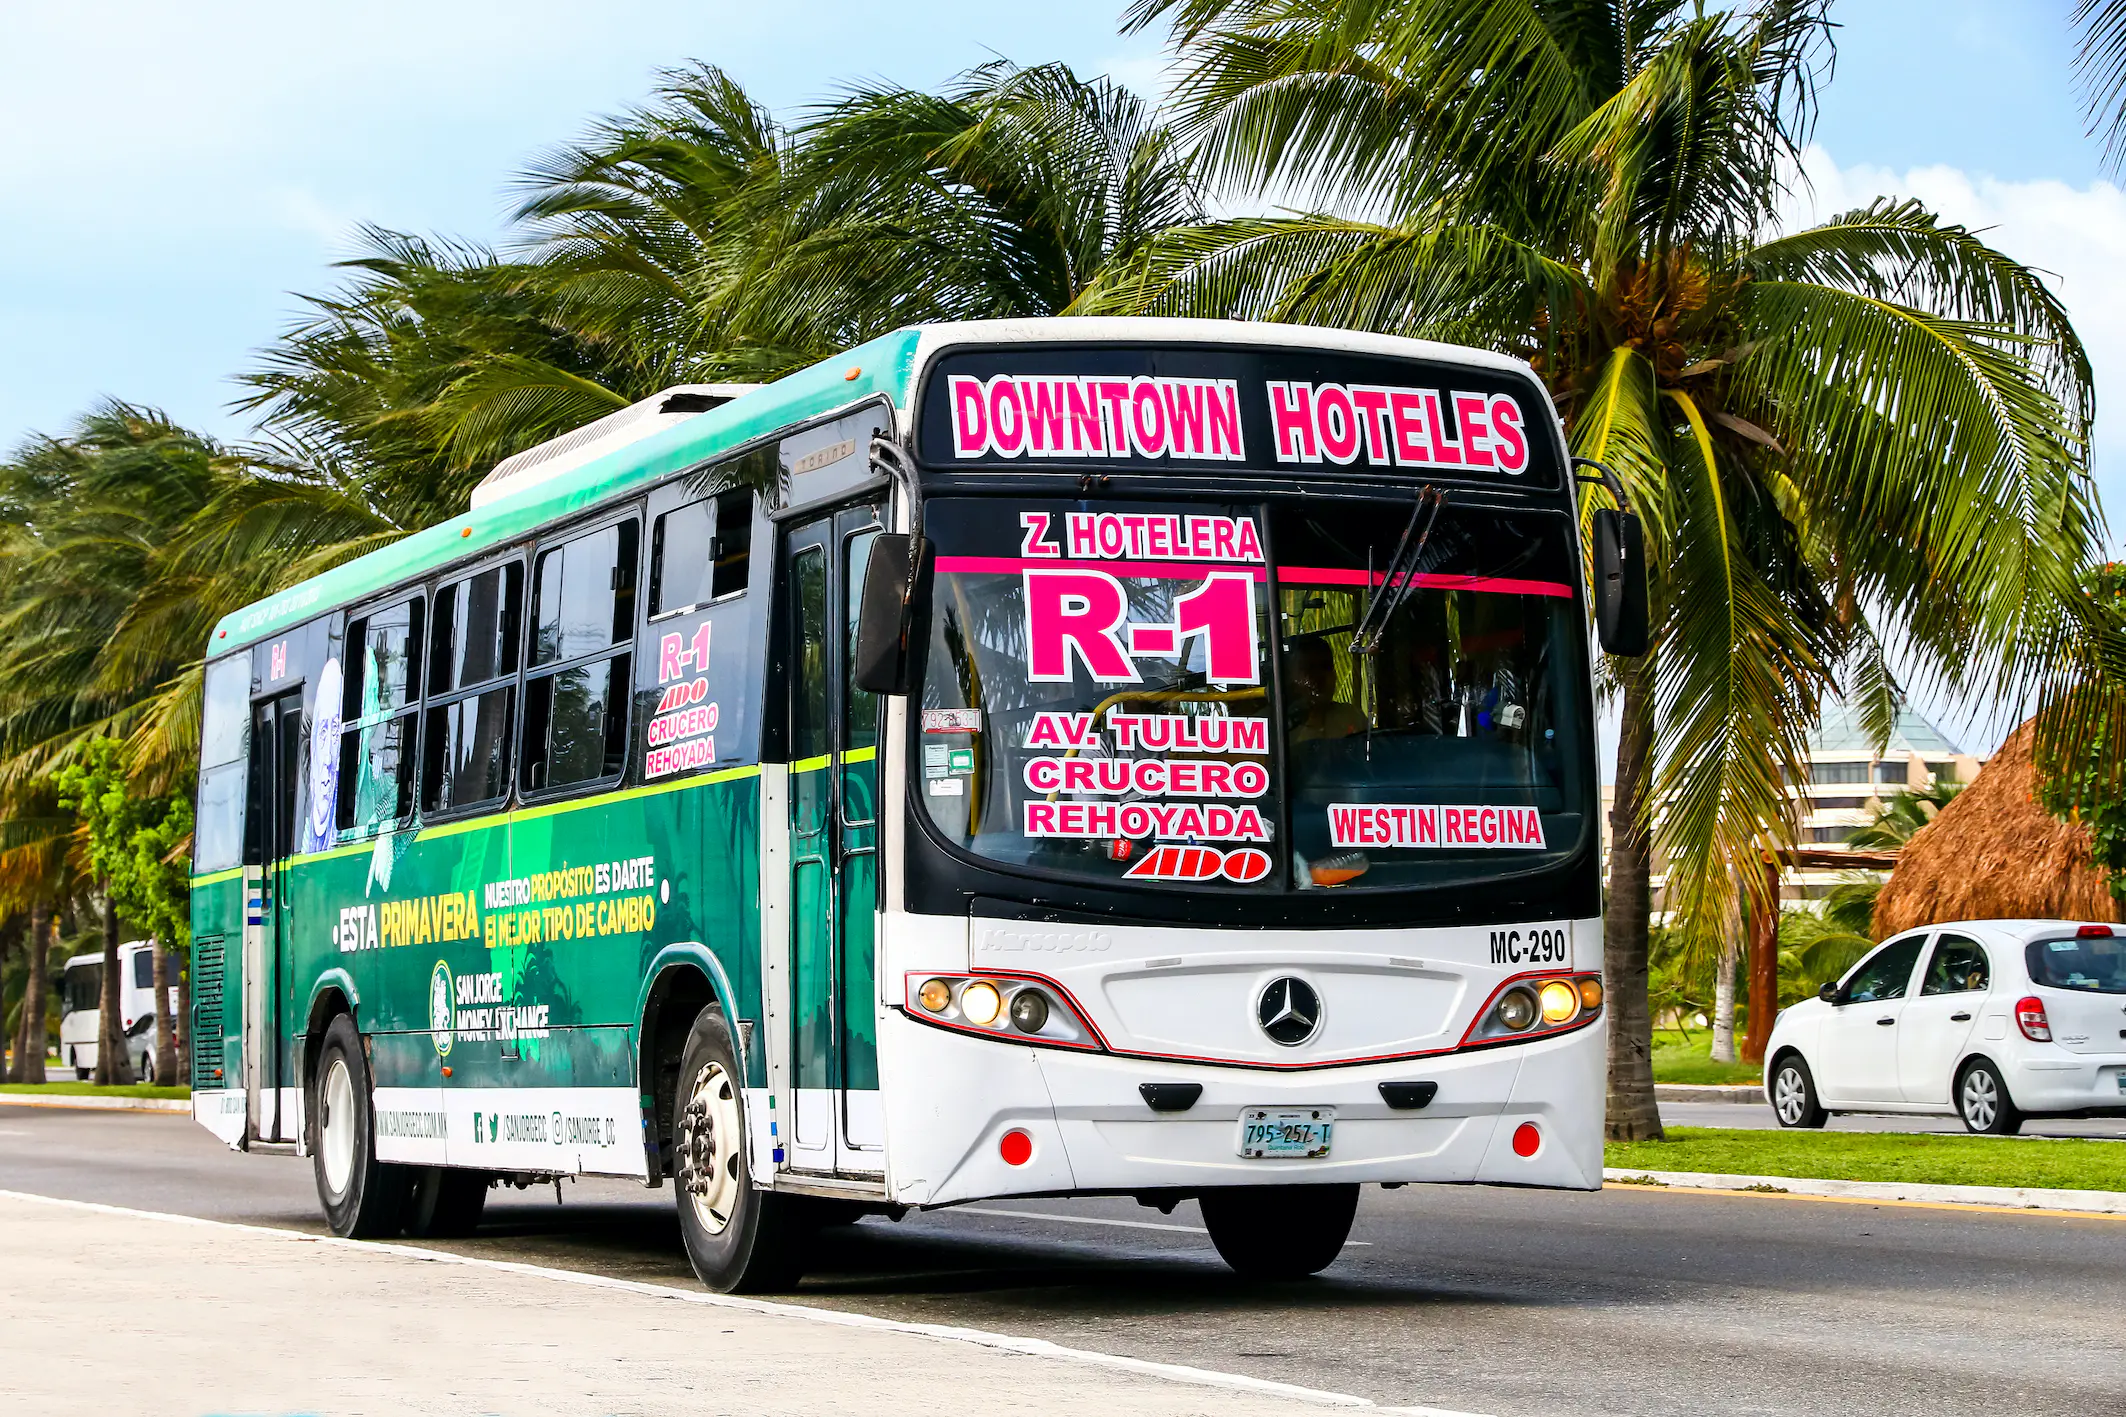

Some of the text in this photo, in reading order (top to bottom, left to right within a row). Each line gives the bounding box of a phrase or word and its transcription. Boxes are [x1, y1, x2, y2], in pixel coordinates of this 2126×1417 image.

[950, 376, 1527, 473] DOWNTOWN HOTELES
[801, 444, 847, 470] TORINO
[1021, 513, 1264, 561] Z. HOTELERA
[1024, 570, 1258, 684] R-1
[659, 620, 711, 684] R-1
[655, 677, 709, 715] ADO
[648, 703, 719, 747] CRUCERO
[1026, 712, 1268, 753] AV. TULUM
[646, 736, 716, 779] REHOYADA
[1024, 757, 1269, 797] CRUCERO
[1024, 801, 1269, 841] REHOYADA
[1333, 808, 1542, 844] WESTIN REGINA
[484, 856, 654, 909] NUESTRO PROPÓSITO ES DARTE
[1123, 845, 1271, 883] ADO
[340, 889, 480, 953] ESTA PRIMAVERA
[498, 909, 541, 947] MEJOR
[542, 905, 573, 942] TIPO
[576, 902, 595, 939] DE
[597, 894, 655, 936] CAMBIO
[981, 929, 1112, 953] Marcopolo
[1490, 929, 1565, 964] MC-290
[456, 972, 502, 1005] SAN JORGE
[456, 1004, 550, 1042] MONEY EXCHANGE
[1248, 1124, 1330, 1143] 795-257-T
